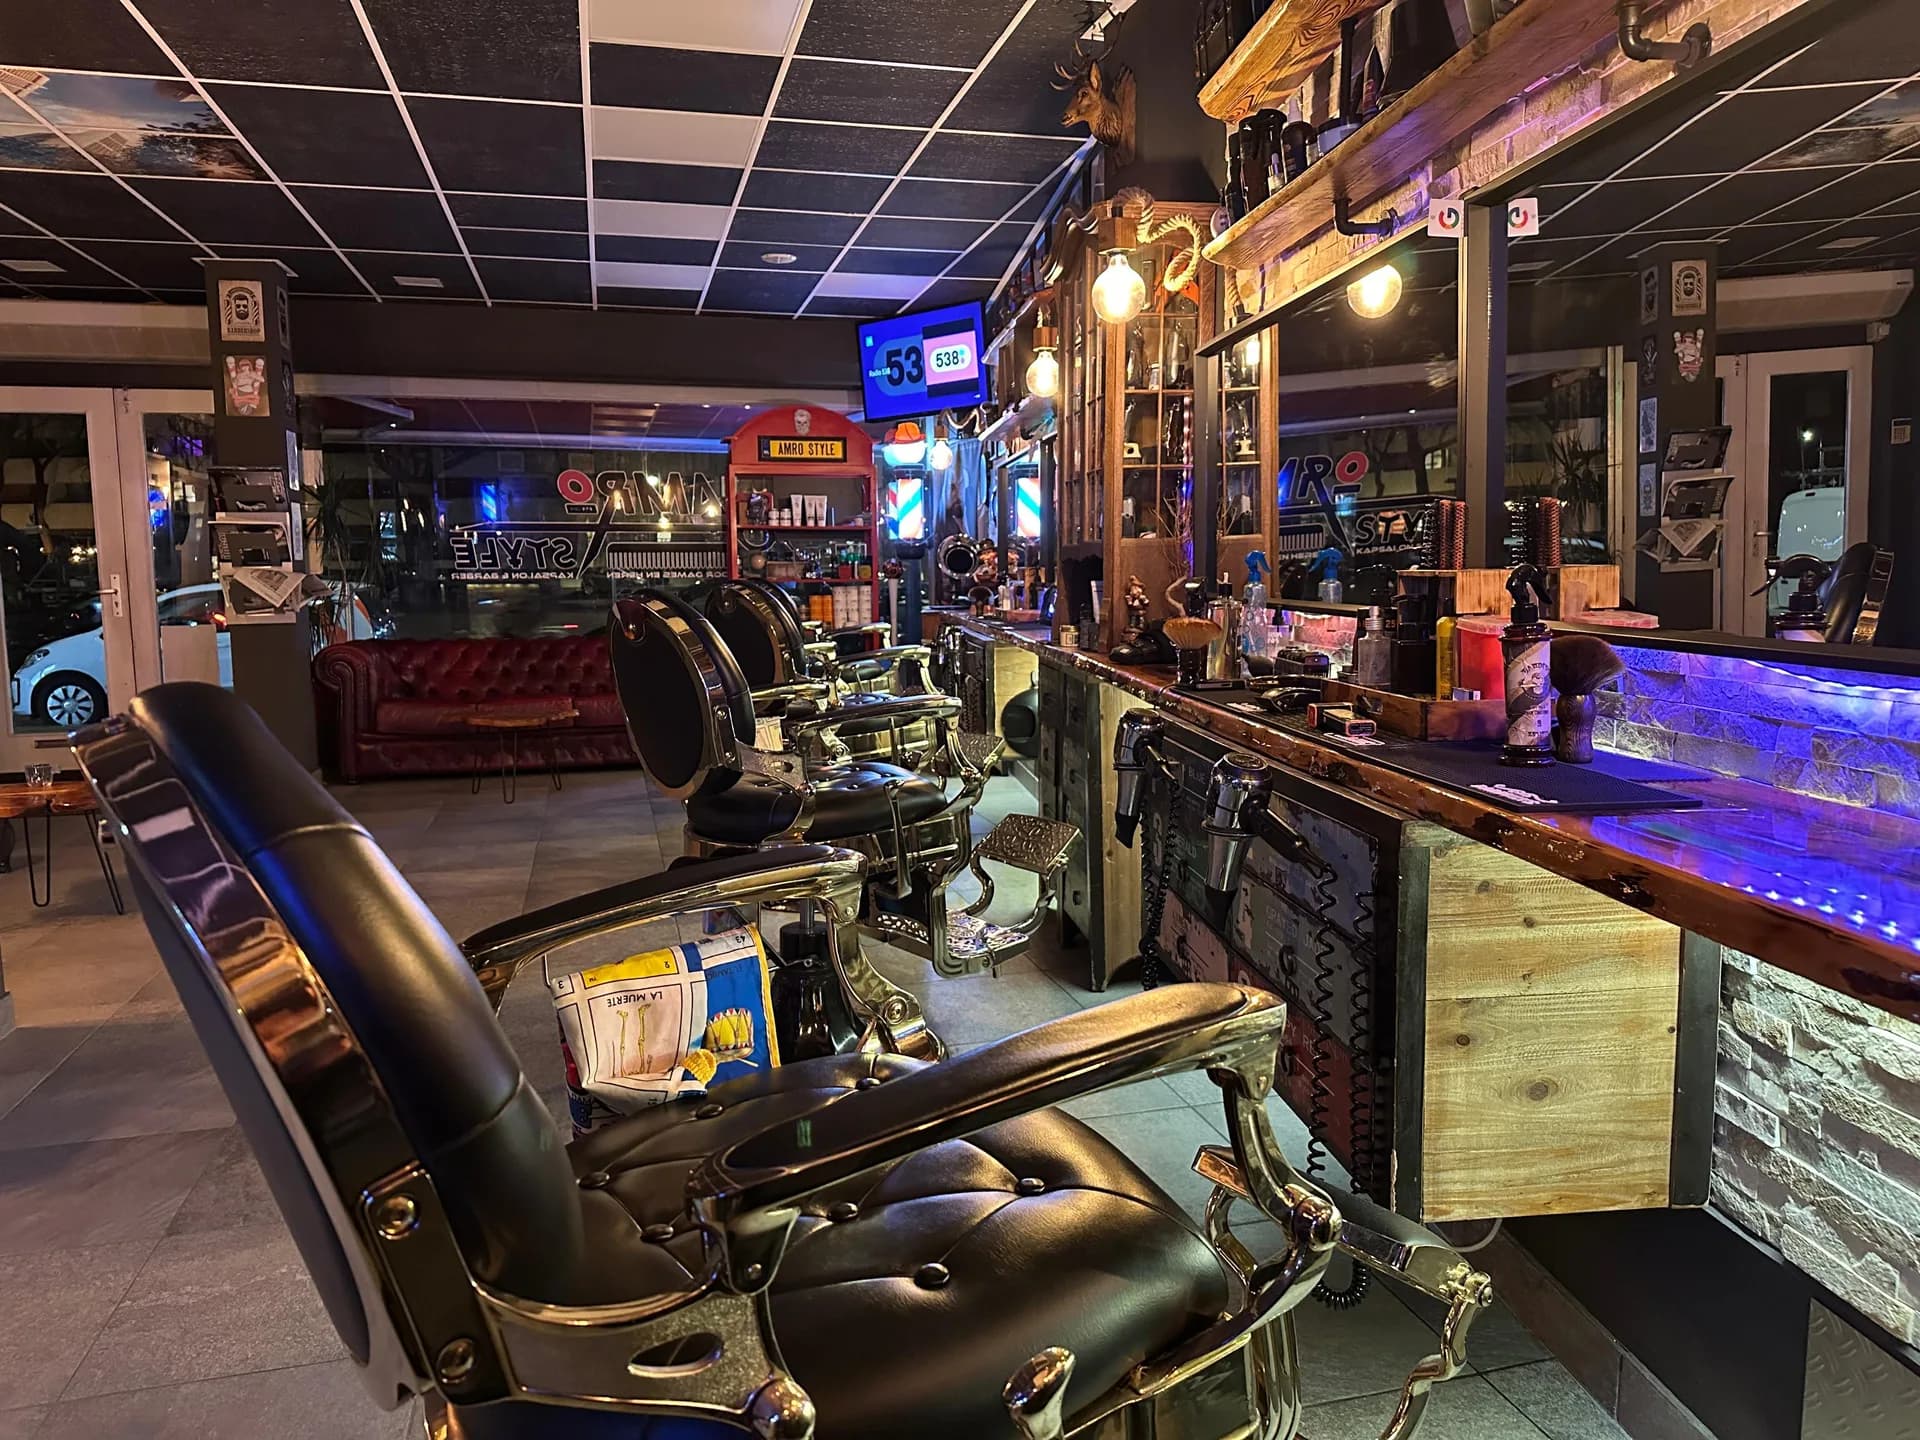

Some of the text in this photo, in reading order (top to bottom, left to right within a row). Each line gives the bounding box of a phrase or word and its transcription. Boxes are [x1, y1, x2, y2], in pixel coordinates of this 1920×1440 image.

[935, 350, 960, 368] 538
[778, 442, 836, 456] AMRO STYLE
[1354, 509, 1426, 546] STY
[1290, 551, 1319, 560] HERE
[735, 933, 746, 944] 43
[558, 980, 565, 989] 3
[608, 991, 663, 1008] LA MUERTE
